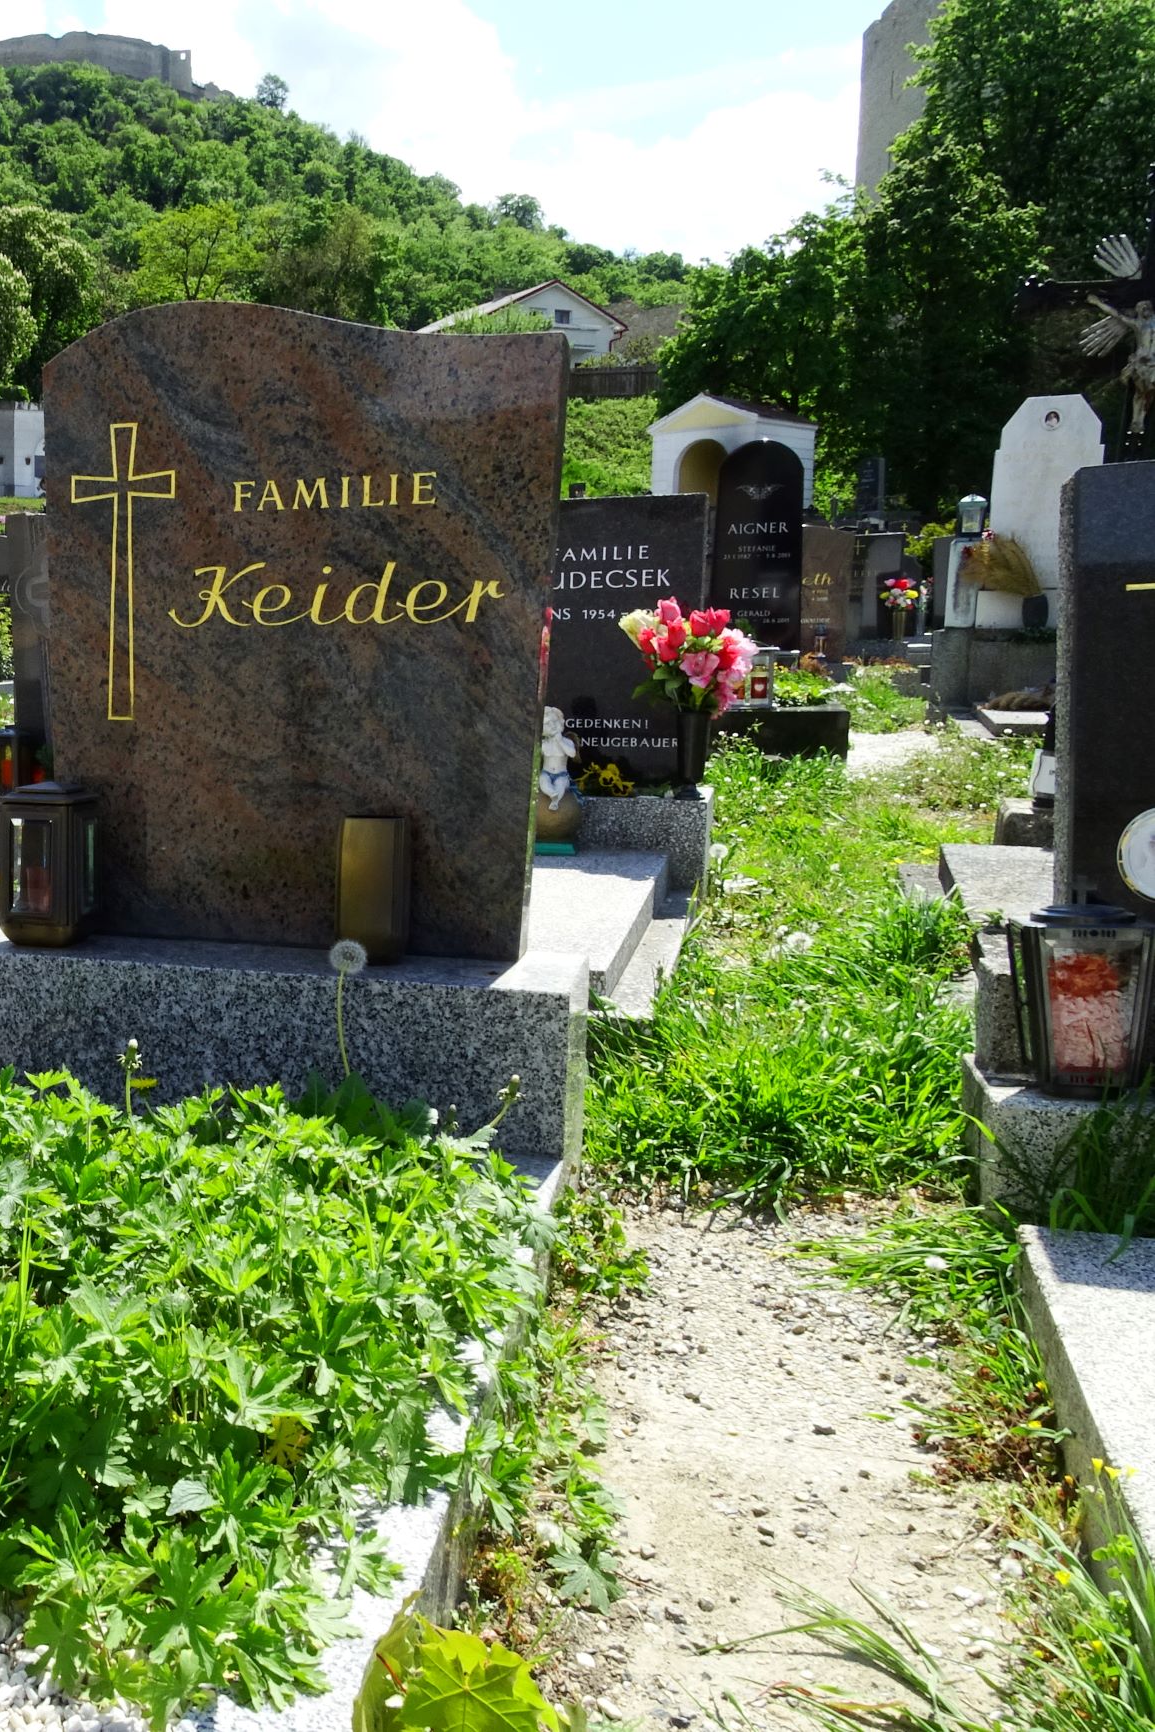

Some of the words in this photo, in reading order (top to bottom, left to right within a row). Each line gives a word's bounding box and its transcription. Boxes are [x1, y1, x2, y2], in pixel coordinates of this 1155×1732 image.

[232, 471, 438, 513] FAMILIE
[727, 521, 789, 536] AIGNER
[550, 568, 671, 590] UDECSEK
[167, 561, 506, 628] Keider
[729, 587, 781, 600] RESEL
[550, 607, 571, 621] NS
[582, 608, 616, 620] 1954
[580, 736, 679, 749] NEUGEBAUER
